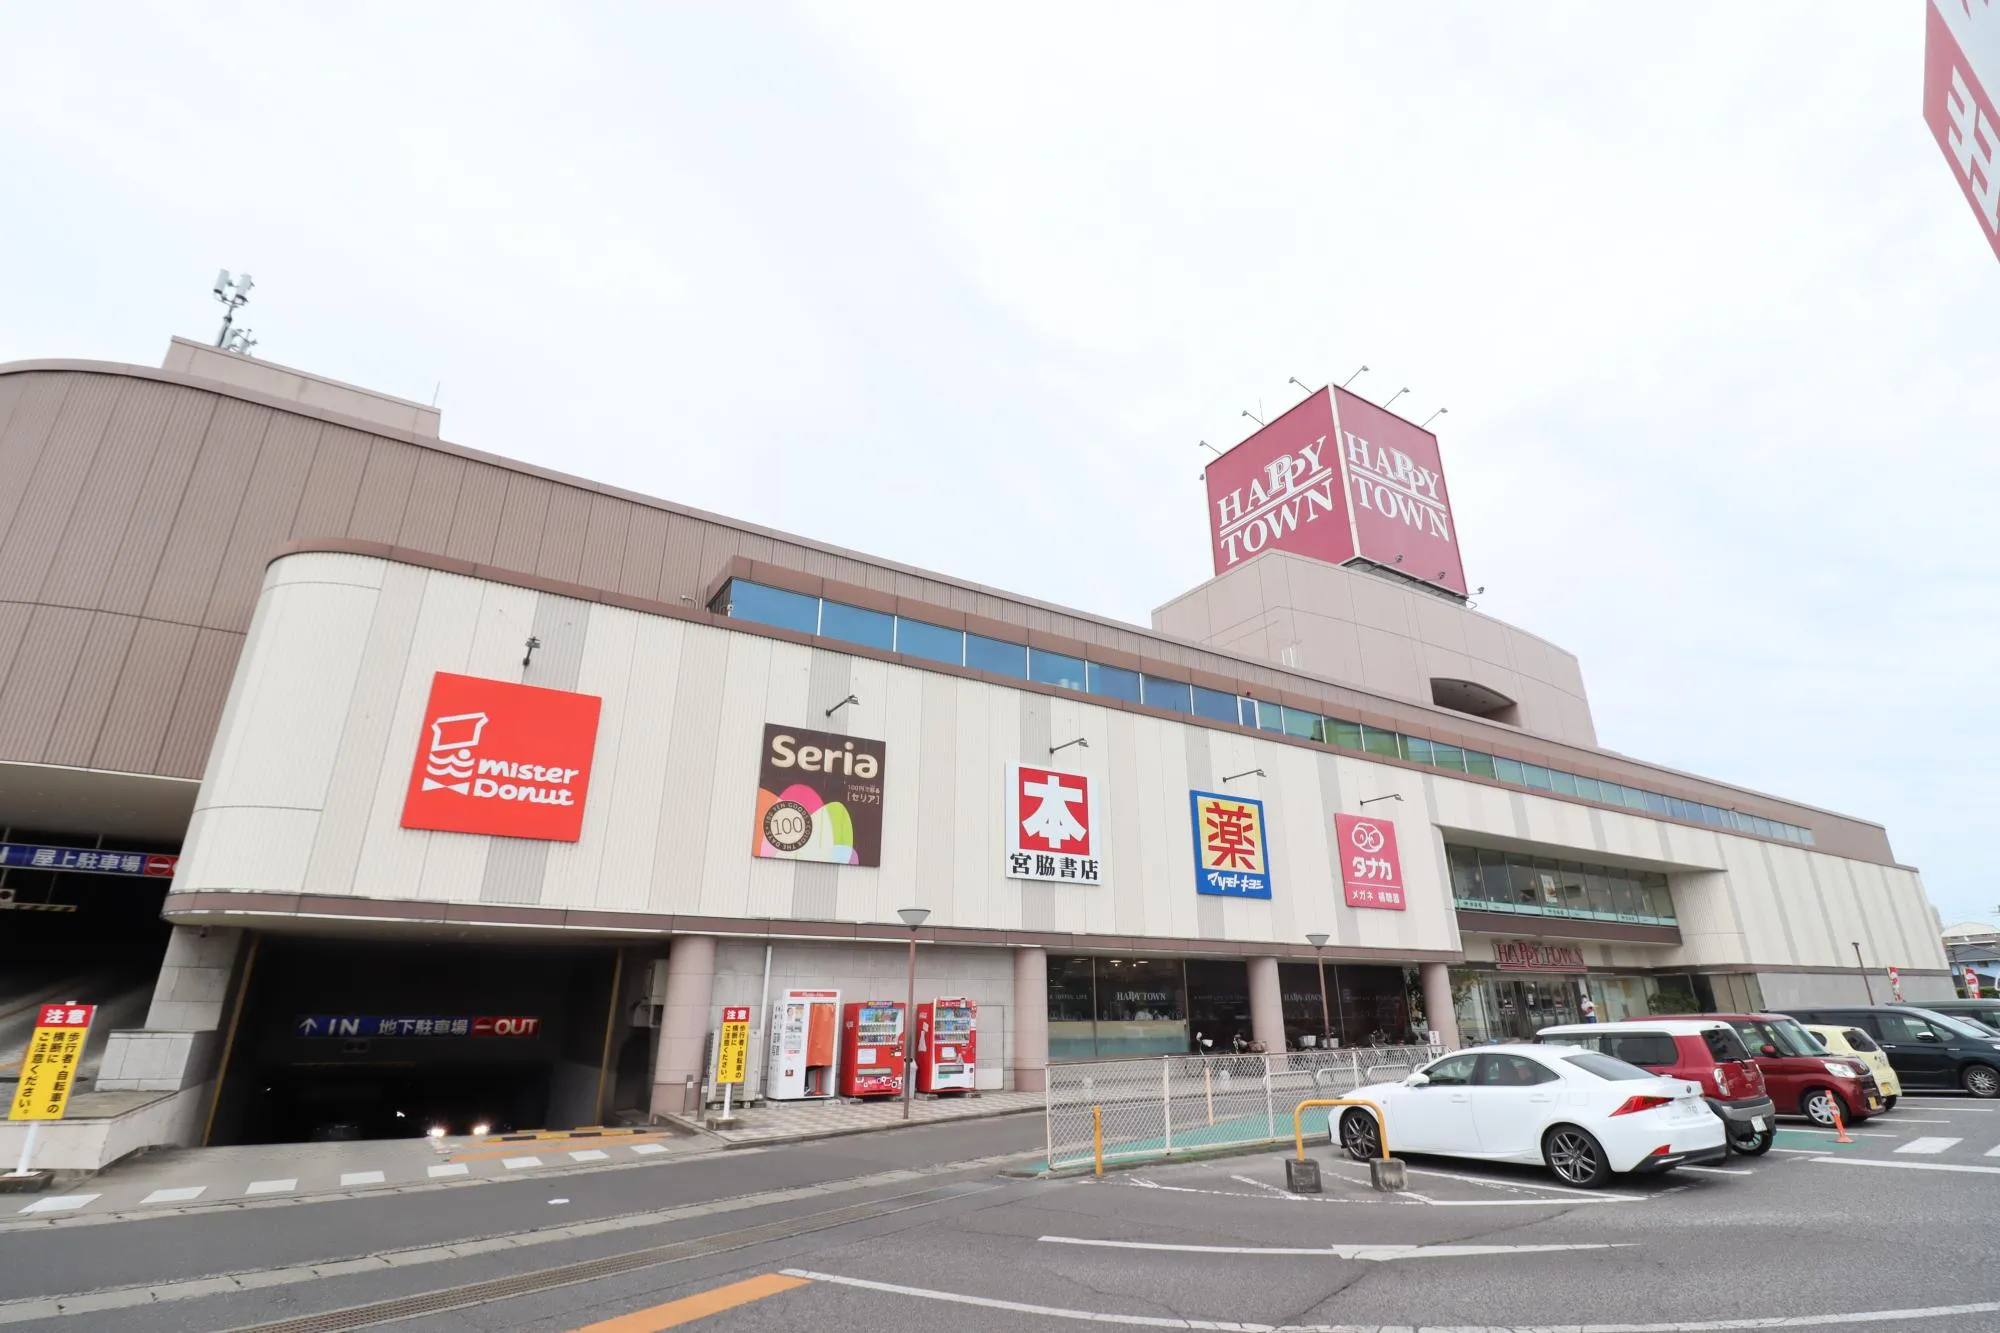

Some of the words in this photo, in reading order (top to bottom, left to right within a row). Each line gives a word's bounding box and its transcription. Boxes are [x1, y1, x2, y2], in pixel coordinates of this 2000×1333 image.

[1343, 431, 1440, 500] HAPPY
[1217, 436, 1327, 528] HAPPY
[1351, 475, 1450, 542] TOWN
[1220, 479, 1333, 566] TOWN
[771, 734, 878, 779] Seria
[1021, 774, 1087, 849] 本
[772, 816, 803, 836] 100
[1205, 801, 1257, 871] 薬
[31, 848, 142, 873] 屋上駐車場
[1010, 852, 1099, 881] 宮脇書店
[1352, 856, 1393, 881] タナカ
[1352, 889, 1374, 902] メガネ
[44, 1009, 87, 1024] 注意
[328, 1018, 360, 1035] IN
[378, 1018, 469, 1036] 地下駐車場
[494, 1018, 538, 1036] OUT
[726, 1009, 747, 1020] 注意
